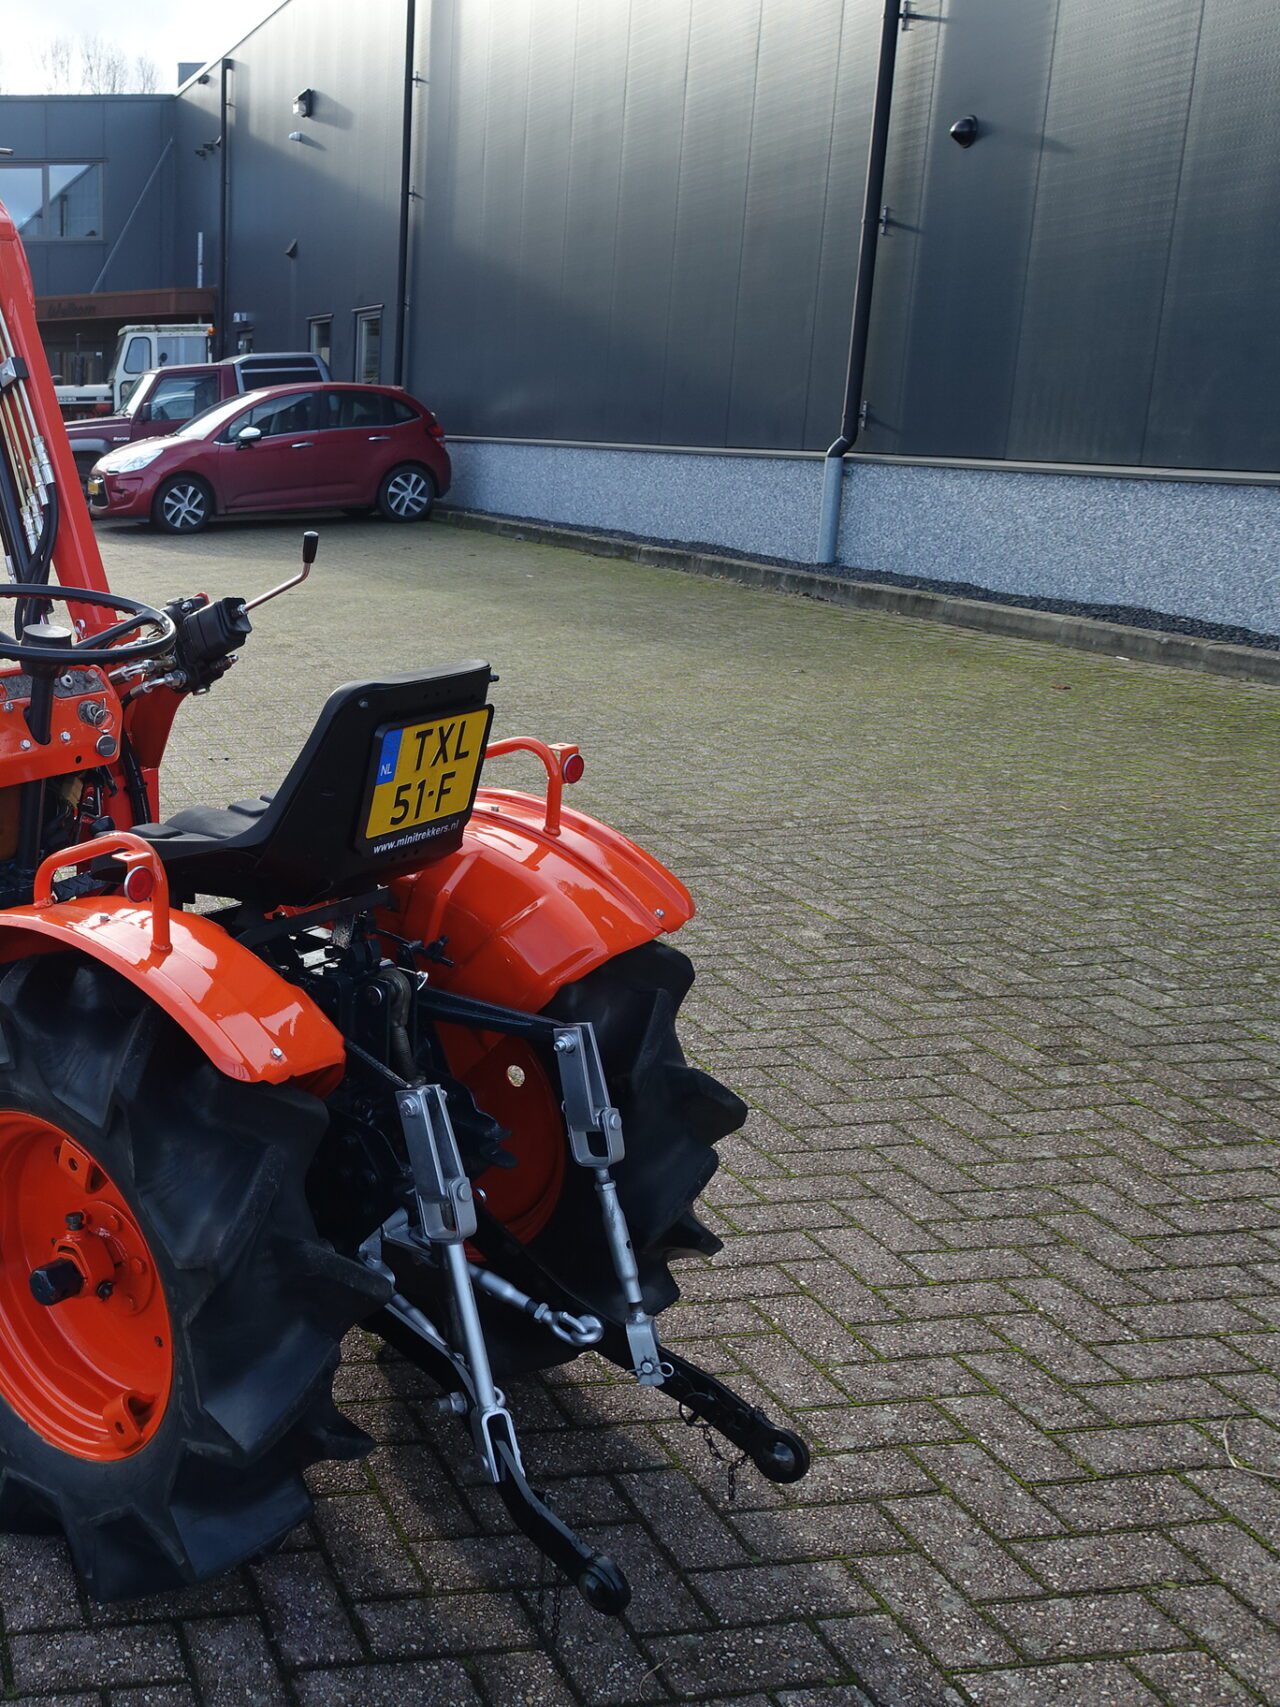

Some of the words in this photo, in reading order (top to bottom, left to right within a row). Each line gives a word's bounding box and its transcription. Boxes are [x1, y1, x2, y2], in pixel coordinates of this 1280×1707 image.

[415, 720, 469, 771] TXL
[380, 763, 392, 777] NL
[390, 771, 456, 825] 51-F
[373, 819, 460, 854] www.minitrekkers.nl
